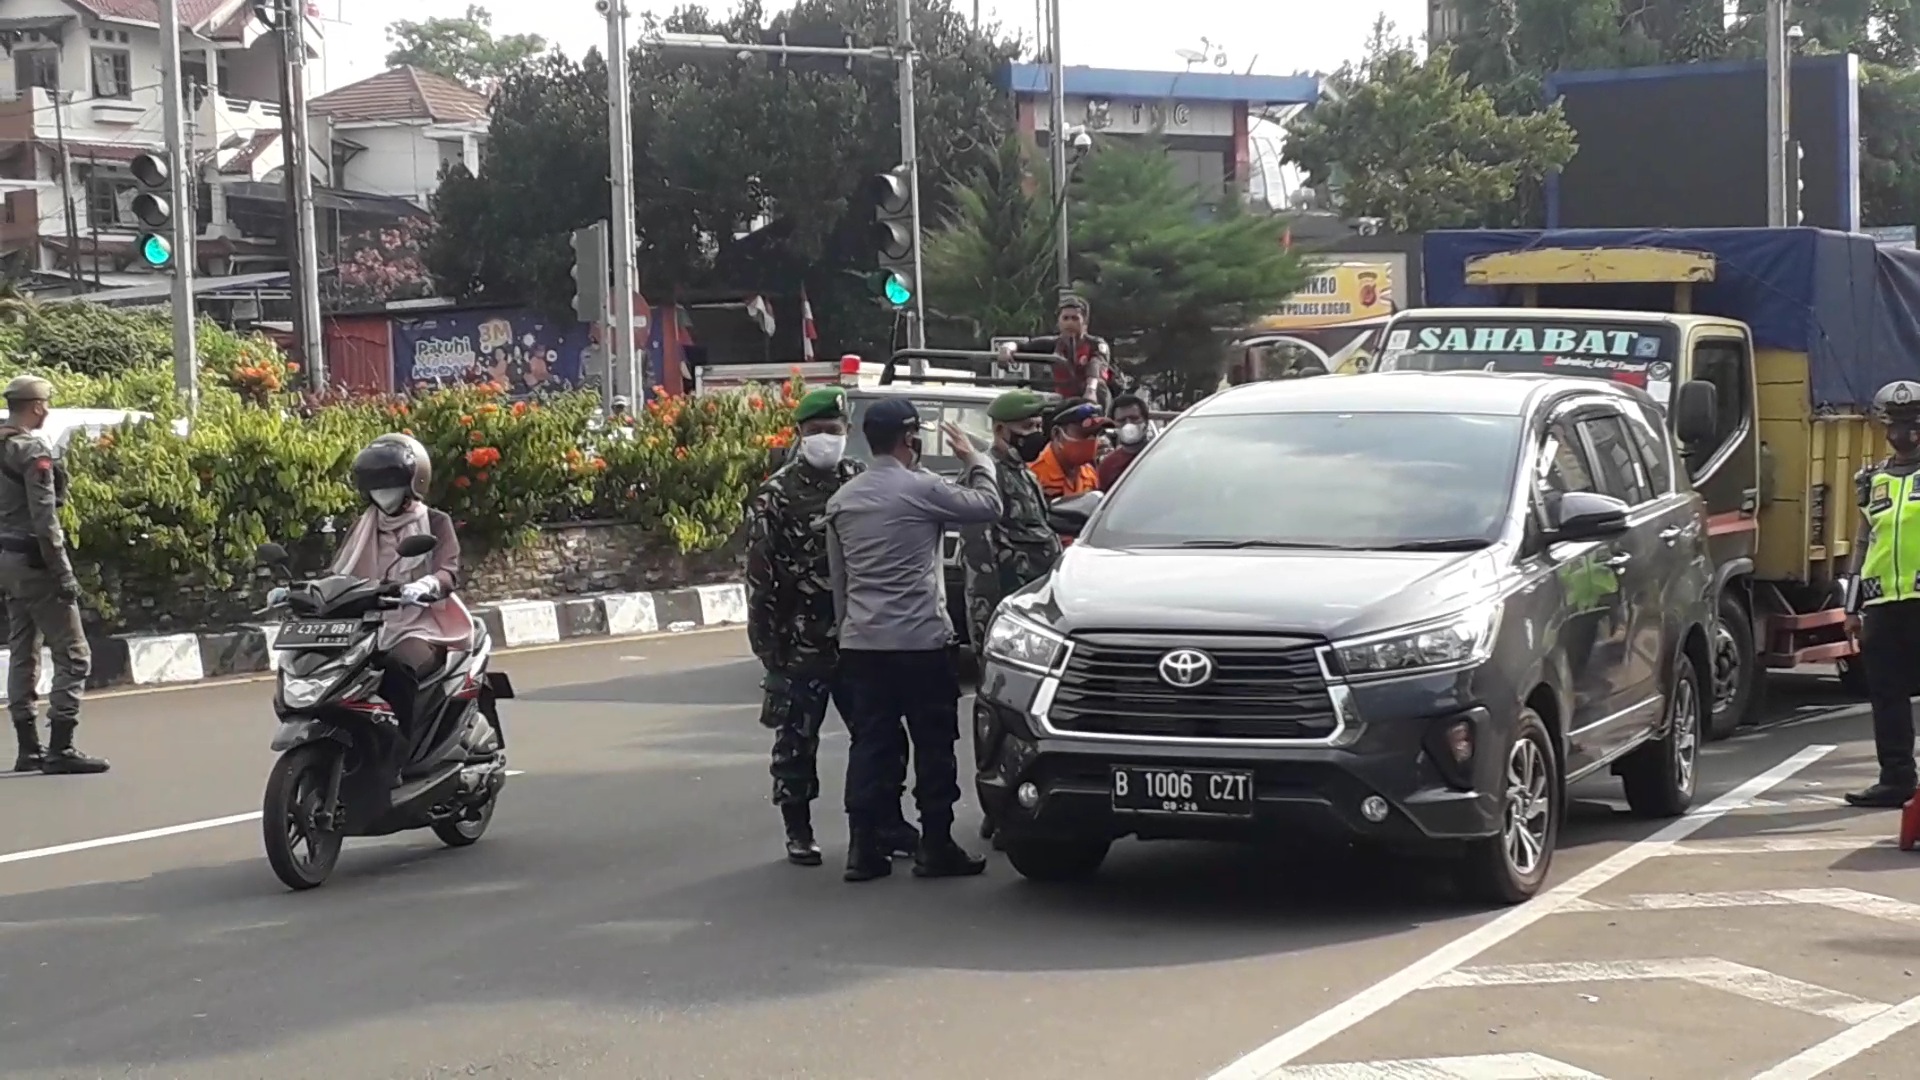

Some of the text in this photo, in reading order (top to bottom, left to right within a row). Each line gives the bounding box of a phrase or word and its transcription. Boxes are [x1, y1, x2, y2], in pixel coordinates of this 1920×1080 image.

[1287, 302, 1319, 315] POLRES
[1321, 302, 1352, 315] BOGOR
[479, 320, 512, 344] 3M
[1416, 326, 1638, 355] SAHABAT
[417, 336, 471, 356] Patuhi
[284, 625, 293, 635] F
[1115, 771, 1247, 800] B 1006 CZT
